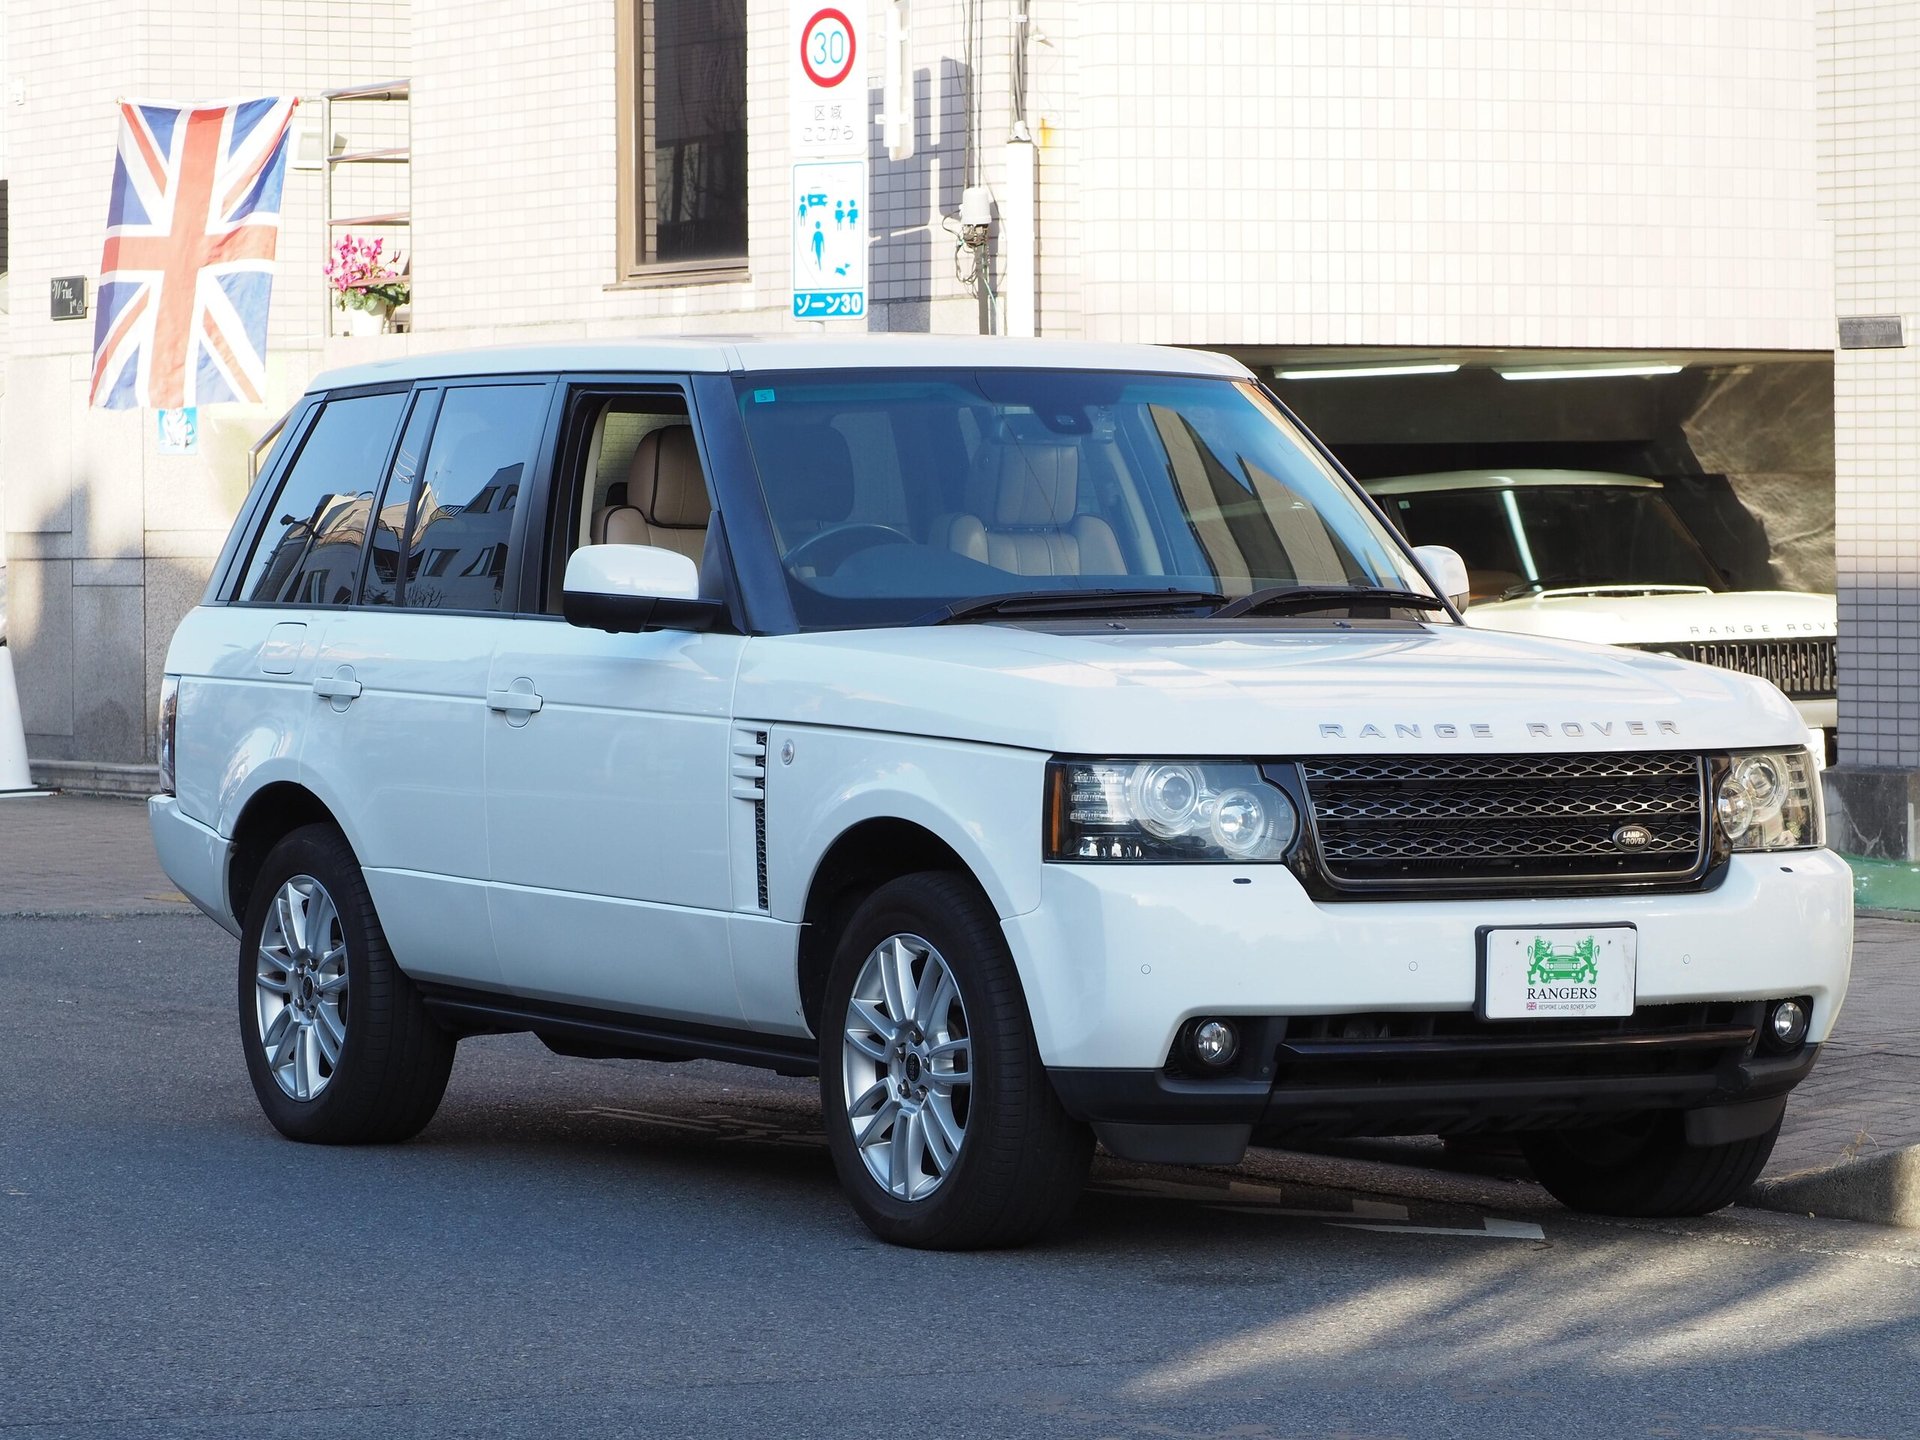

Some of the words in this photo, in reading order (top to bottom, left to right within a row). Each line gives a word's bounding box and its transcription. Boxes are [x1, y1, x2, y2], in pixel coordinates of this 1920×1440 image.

[813, 30, 844, 65] 30
[802, 124, 854, 142] ここから
[1689, 624, 1771, 635] RANGE
[1318, 723, 1494, 740] RANGE
[1525, 720, 1681, 738] ROVER
[1527, 987, 1597, 999] RANGERS
